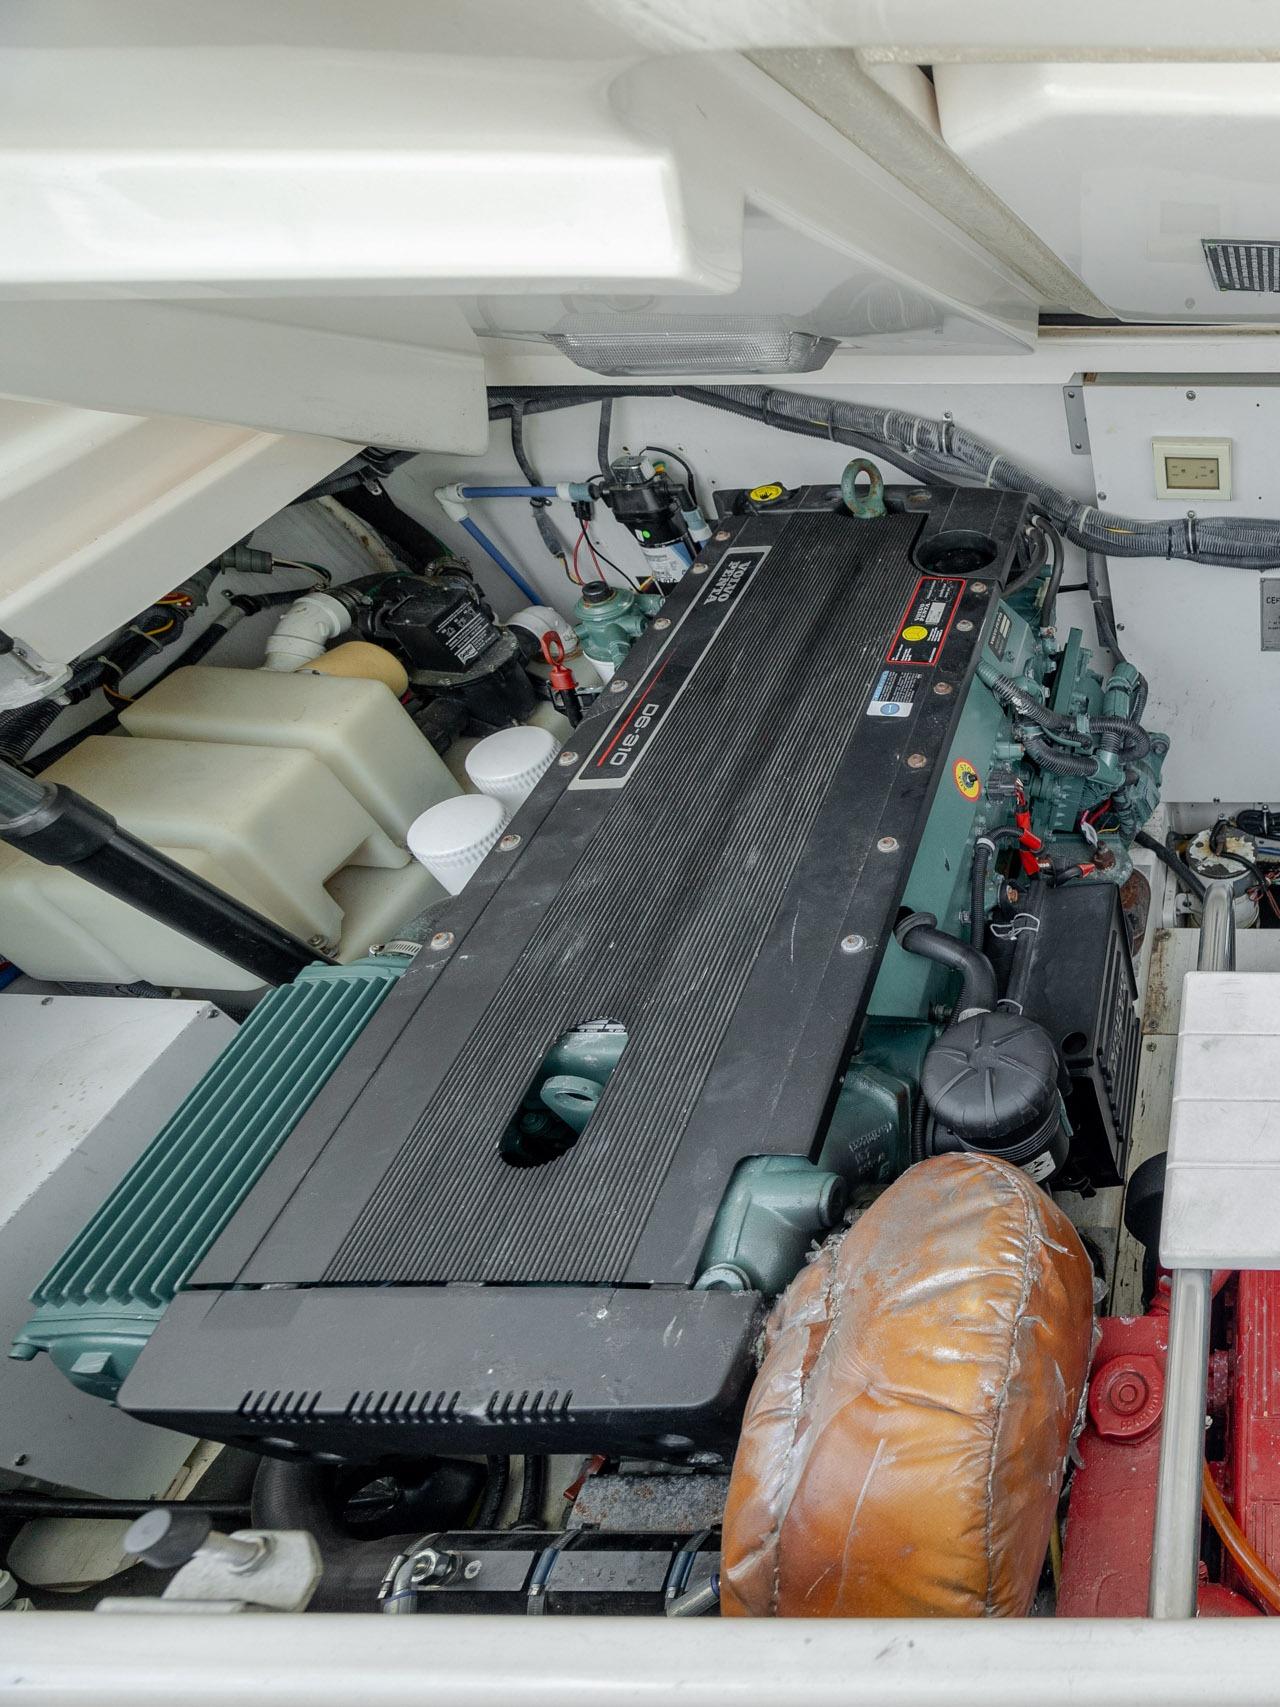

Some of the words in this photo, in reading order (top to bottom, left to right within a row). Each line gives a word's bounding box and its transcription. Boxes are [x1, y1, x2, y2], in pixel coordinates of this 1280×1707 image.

[703, 561, 741, 605] PENTA
[717, 560, 752, 602] VOLVO
[610, 703, 660, 765] D6-310
